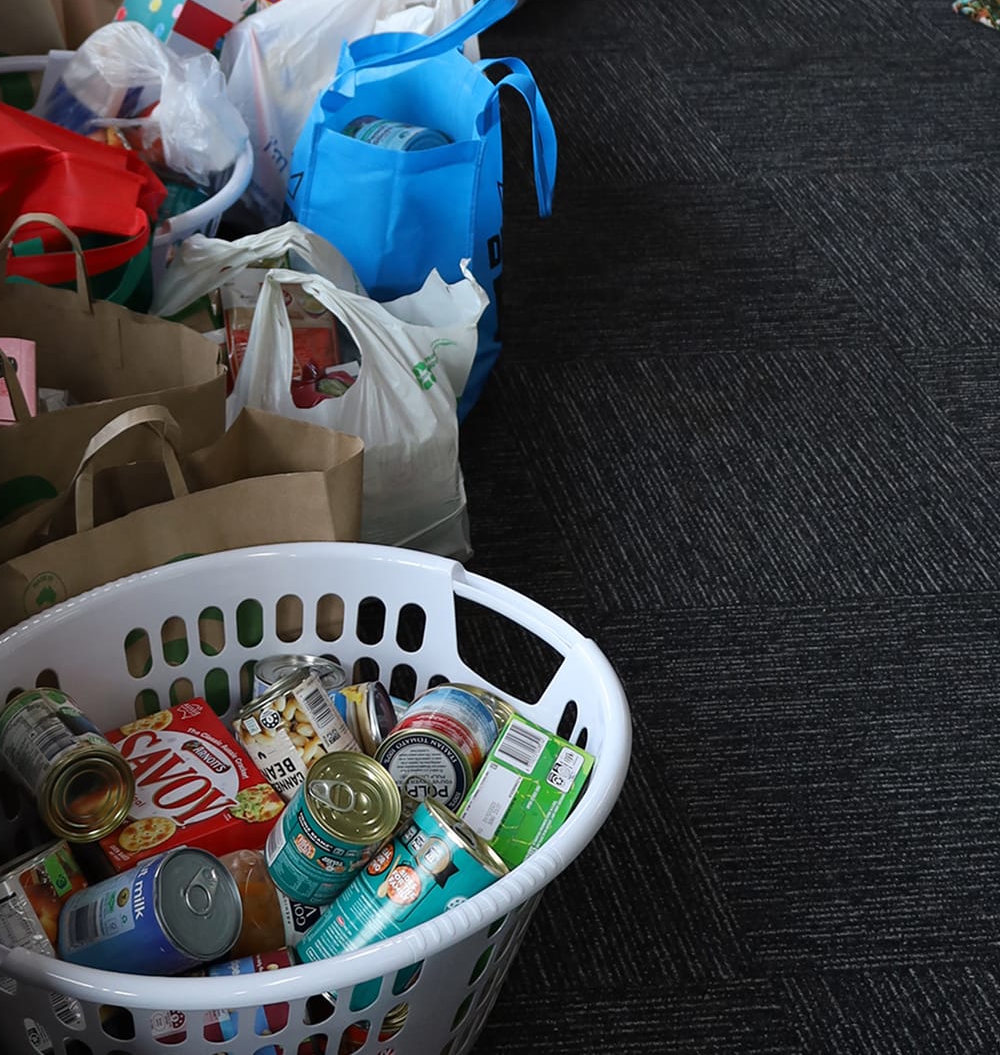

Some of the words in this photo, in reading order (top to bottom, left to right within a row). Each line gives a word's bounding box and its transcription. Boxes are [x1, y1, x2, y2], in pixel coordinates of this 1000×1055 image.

[187, 727, 201, 738] The
[200, 731, 223, 748] Classic
[220, 741, 237, 761] Aussie
[233, 756, 249, 779] Cracker
[396, 736, 429, 750] TOMATO
[430, 739, 458, 763] ITALIAN
[120, 730, 239, 825] SAVOY
[272, 771, 306, 795] CANNE
[398, 785, 449, 799] POLP
[133, 880, 145, 920] milk
